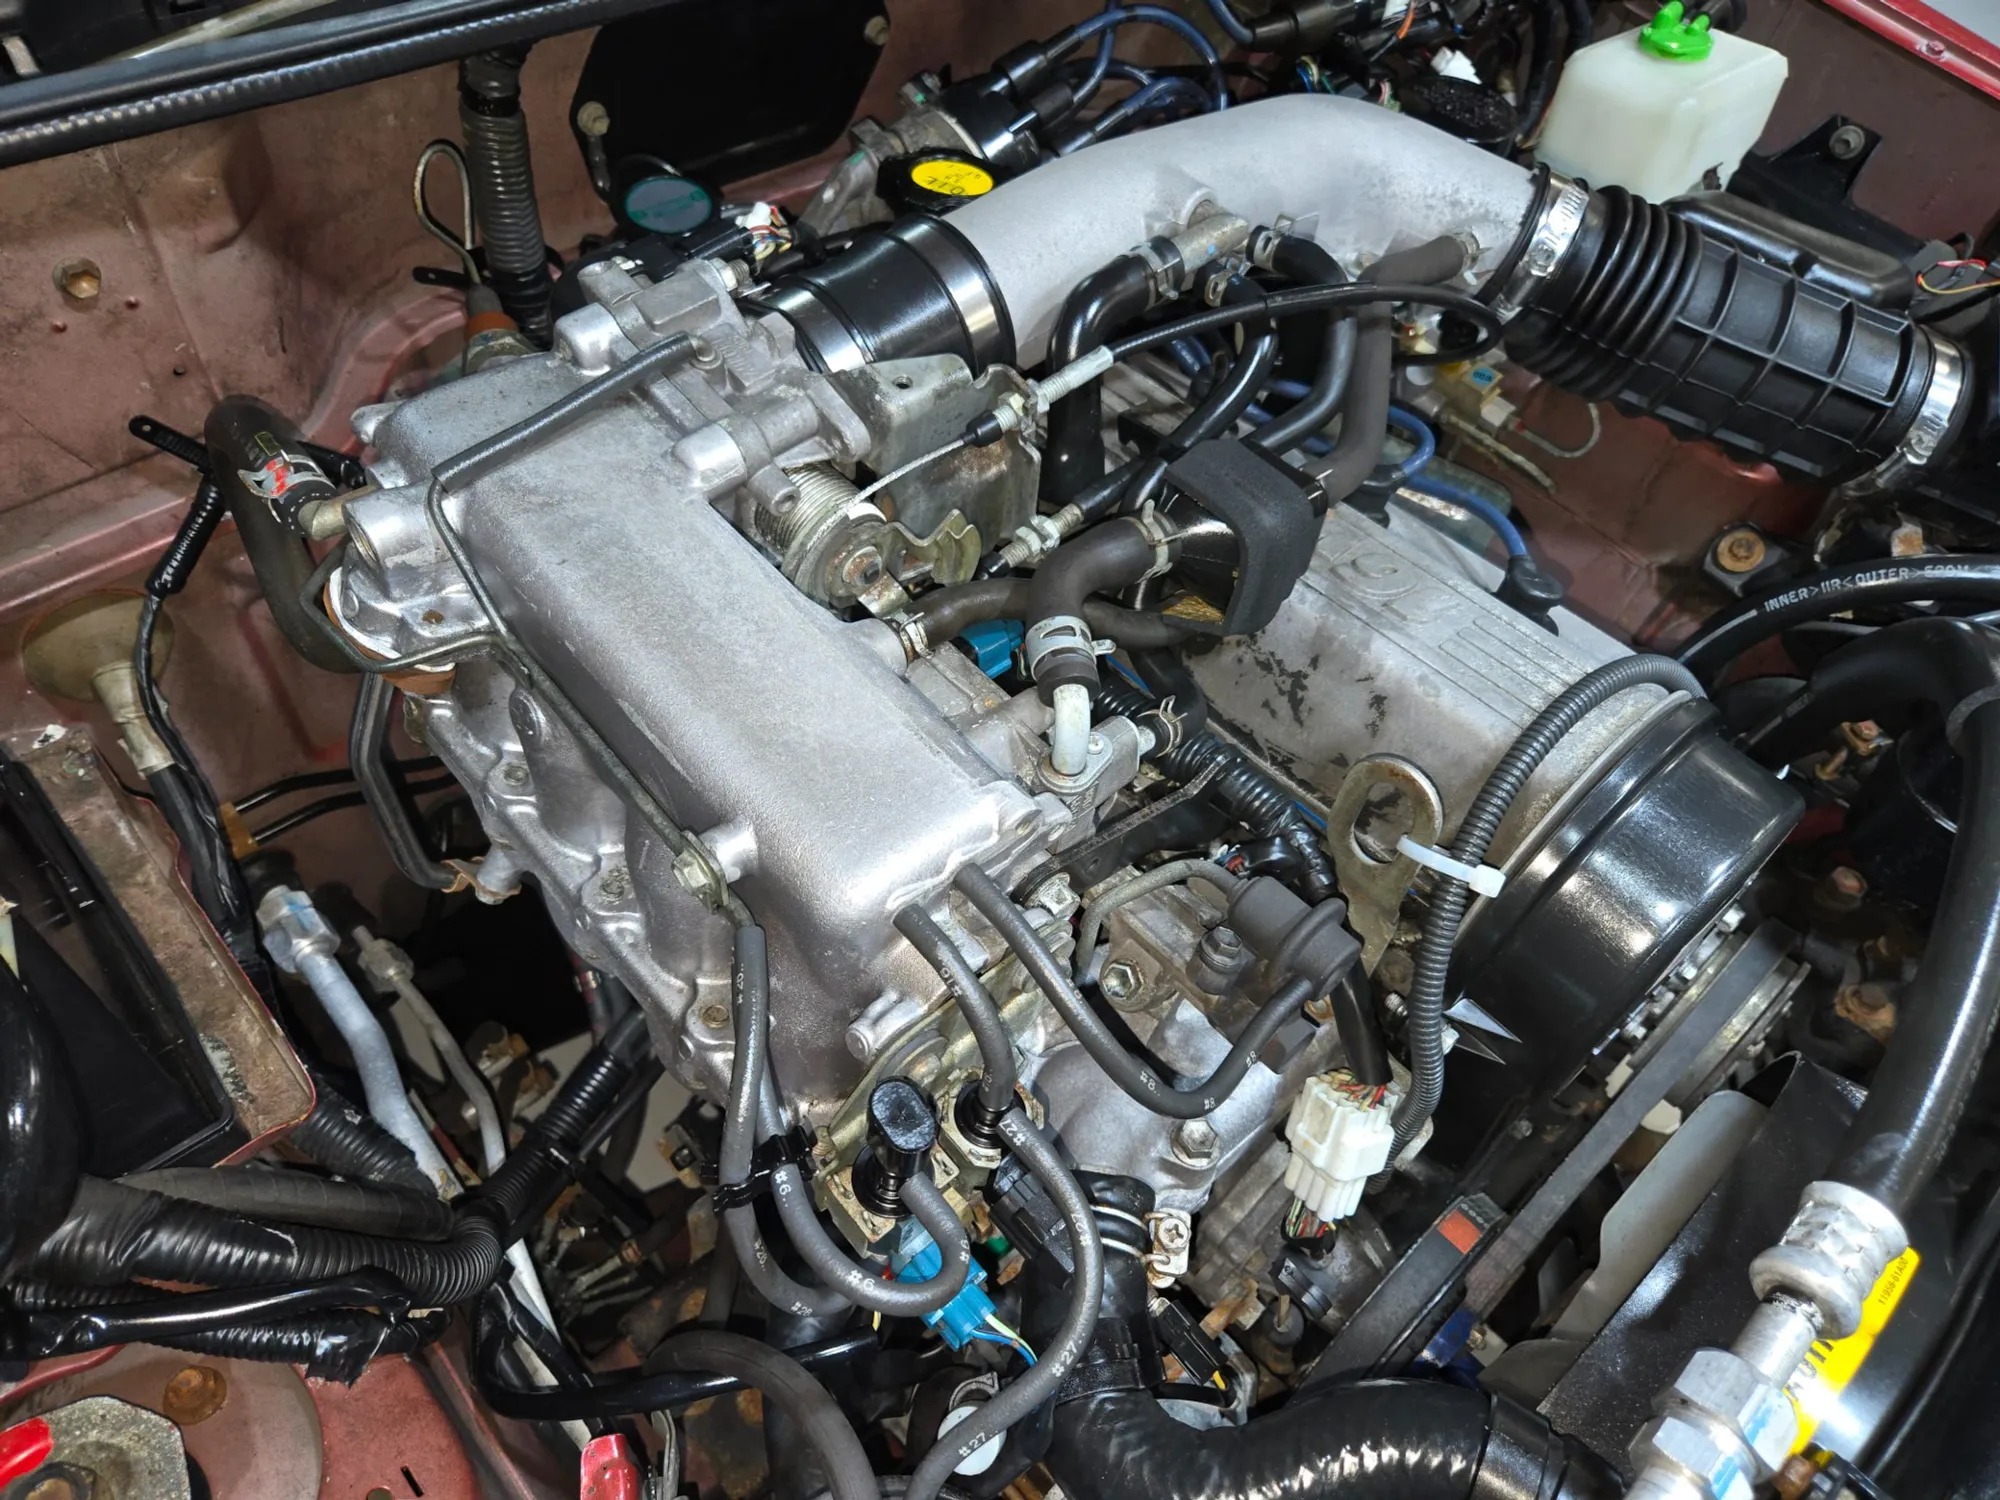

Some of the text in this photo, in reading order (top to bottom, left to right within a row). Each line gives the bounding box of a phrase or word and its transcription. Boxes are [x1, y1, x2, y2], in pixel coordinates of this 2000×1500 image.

[999, 1118, 1027, 1146] #27
[1071, 1213, 1091, 1247] #27
[846, 1269, 876, 1291] #6
